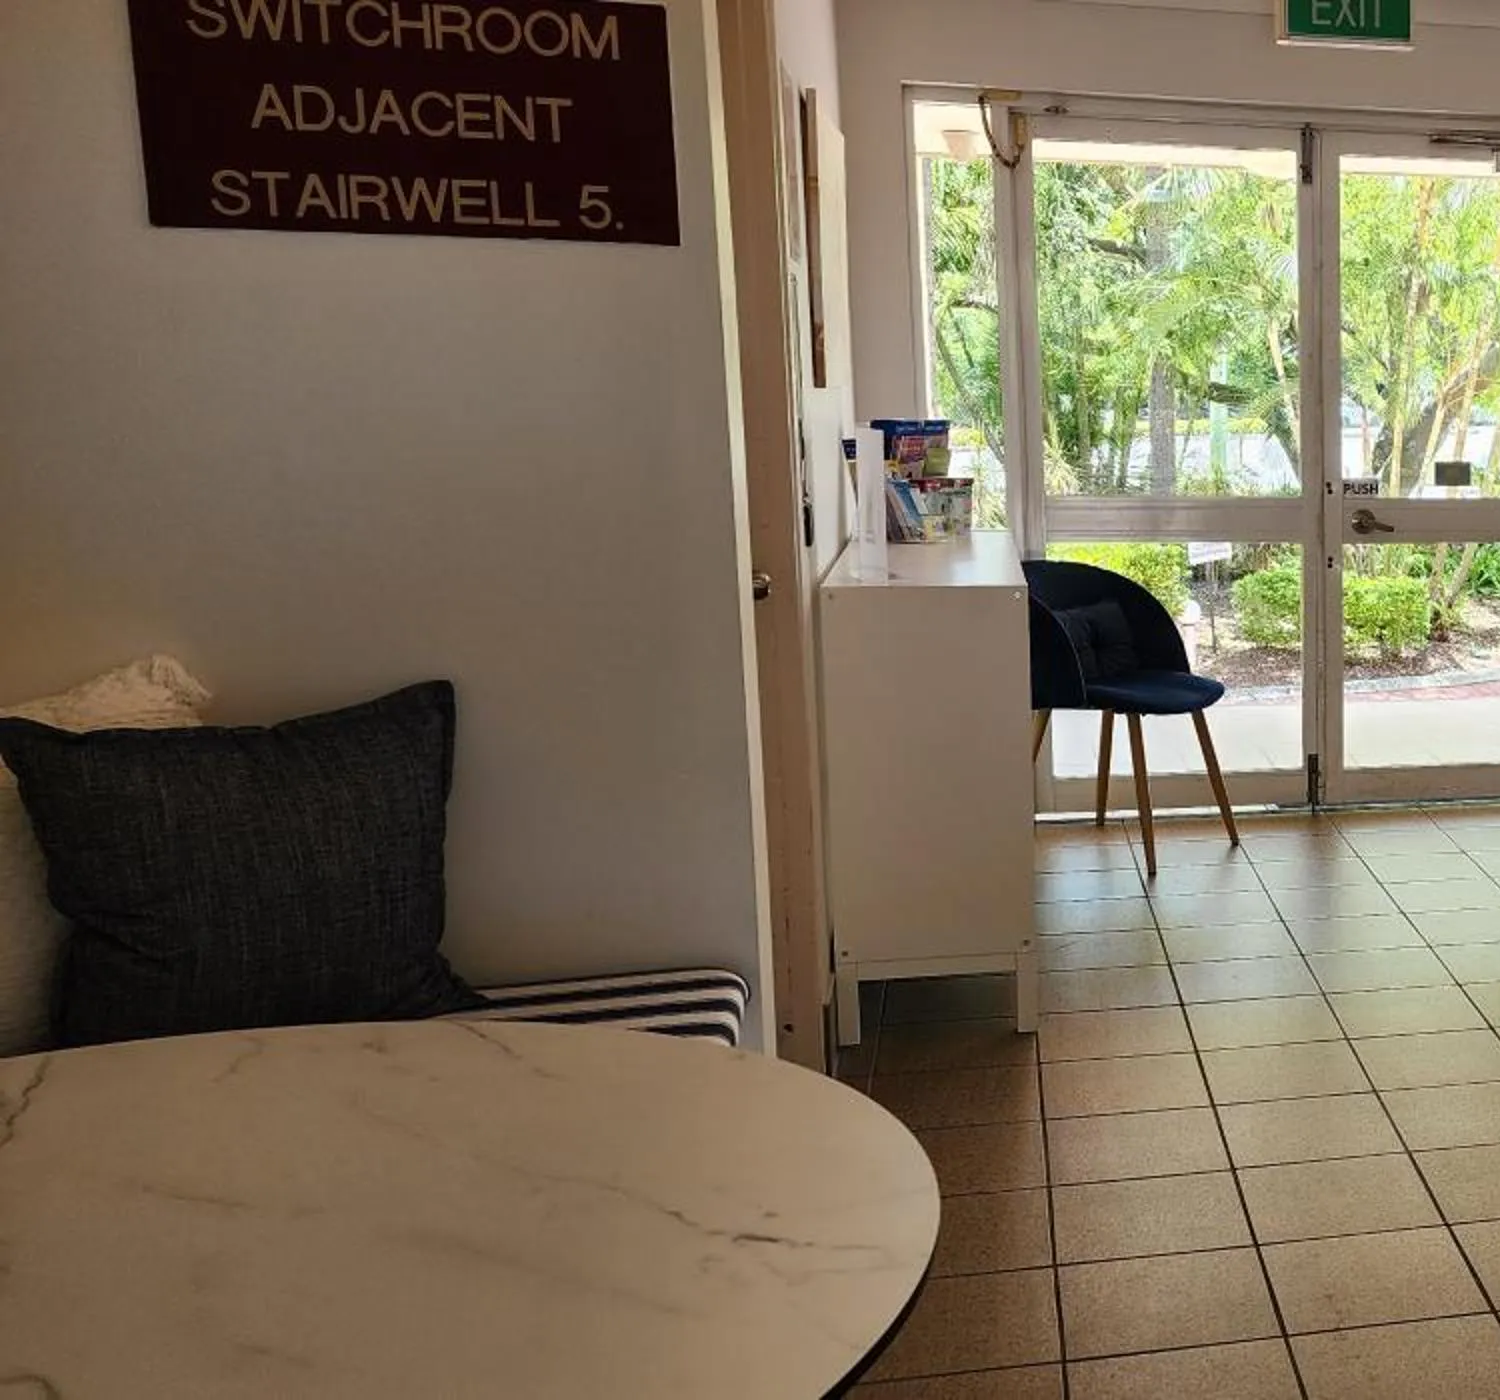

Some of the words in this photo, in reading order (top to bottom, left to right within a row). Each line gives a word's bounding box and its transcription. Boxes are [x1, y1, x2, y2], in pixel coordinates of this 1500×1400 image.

[186, 0, 621, 60] SWITCHROOM
[251, 84, 573, 143] ADJACENT
[210, 169, 560, 227] STAIRWELL
[578, 185, 625, 230] 5.
[1343, 482, 1379, 495] PUSH
